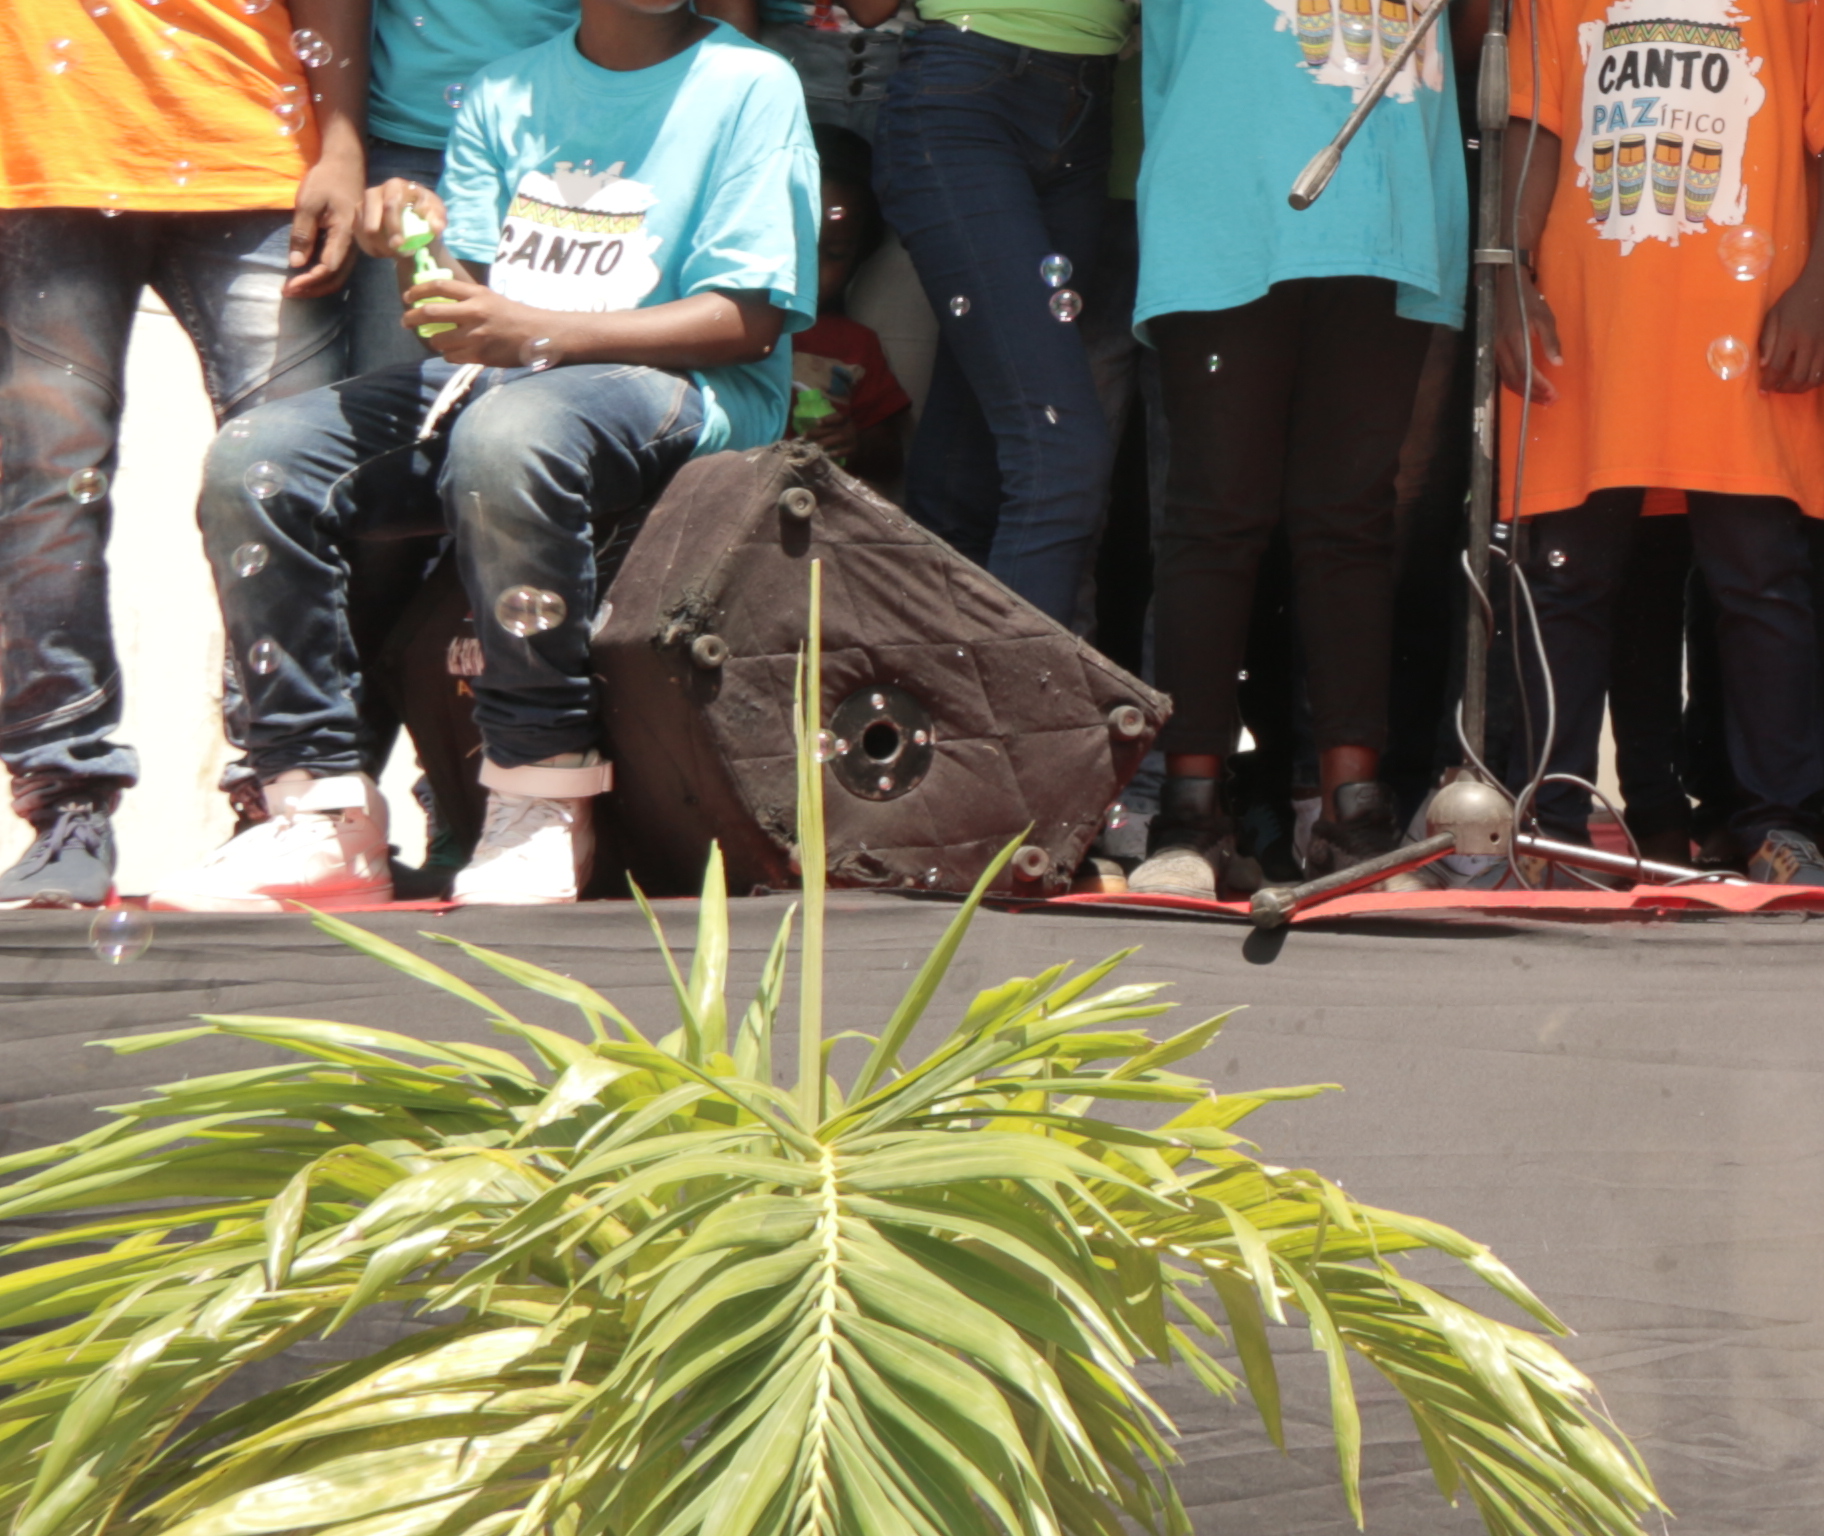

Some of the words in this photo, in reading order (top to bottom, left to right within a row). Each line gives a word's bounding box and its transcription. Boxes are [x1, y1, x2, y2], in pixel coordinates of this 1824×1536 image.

[1598, 48, 1730, 94] CANTO
[1592, 96, 1726, 135] PAZÍFICO
[494, 224, 624, 276] CANTO
